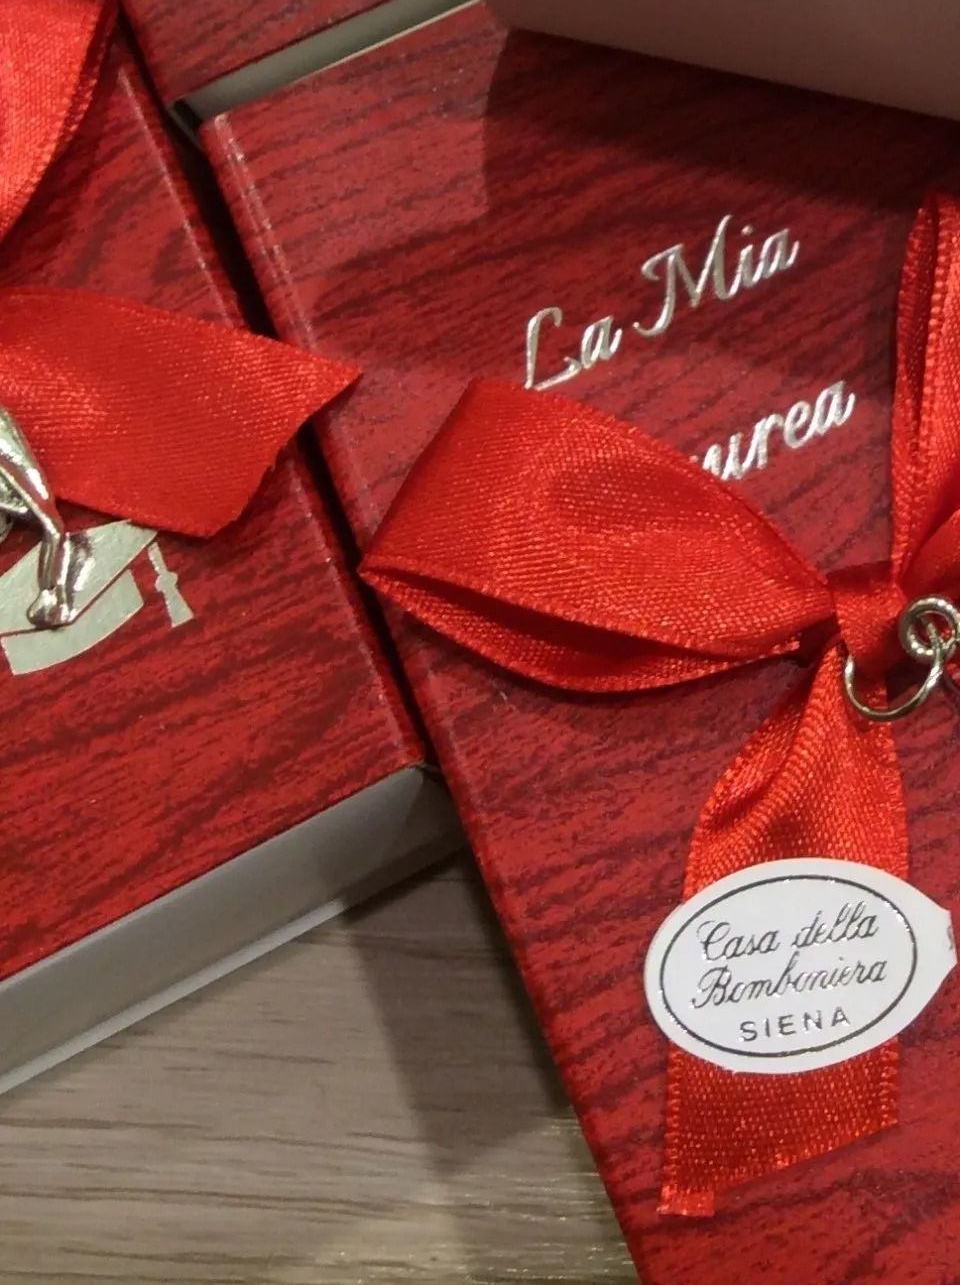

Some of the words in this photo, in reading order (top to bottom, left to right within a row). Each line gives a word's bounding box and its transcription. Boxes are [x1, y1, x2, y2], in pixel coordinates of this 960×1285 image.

[524, 306, 623, 391] La
[633, 214, 800, 337] Mia
[690, 380, 856, 481] urea
[696, 920, 780, 962] Casa
[791, 900, 879, 950] della
[690, 951, 888, 1009] Bomboniera
[739, 1006, 851, 1043] SIENA
